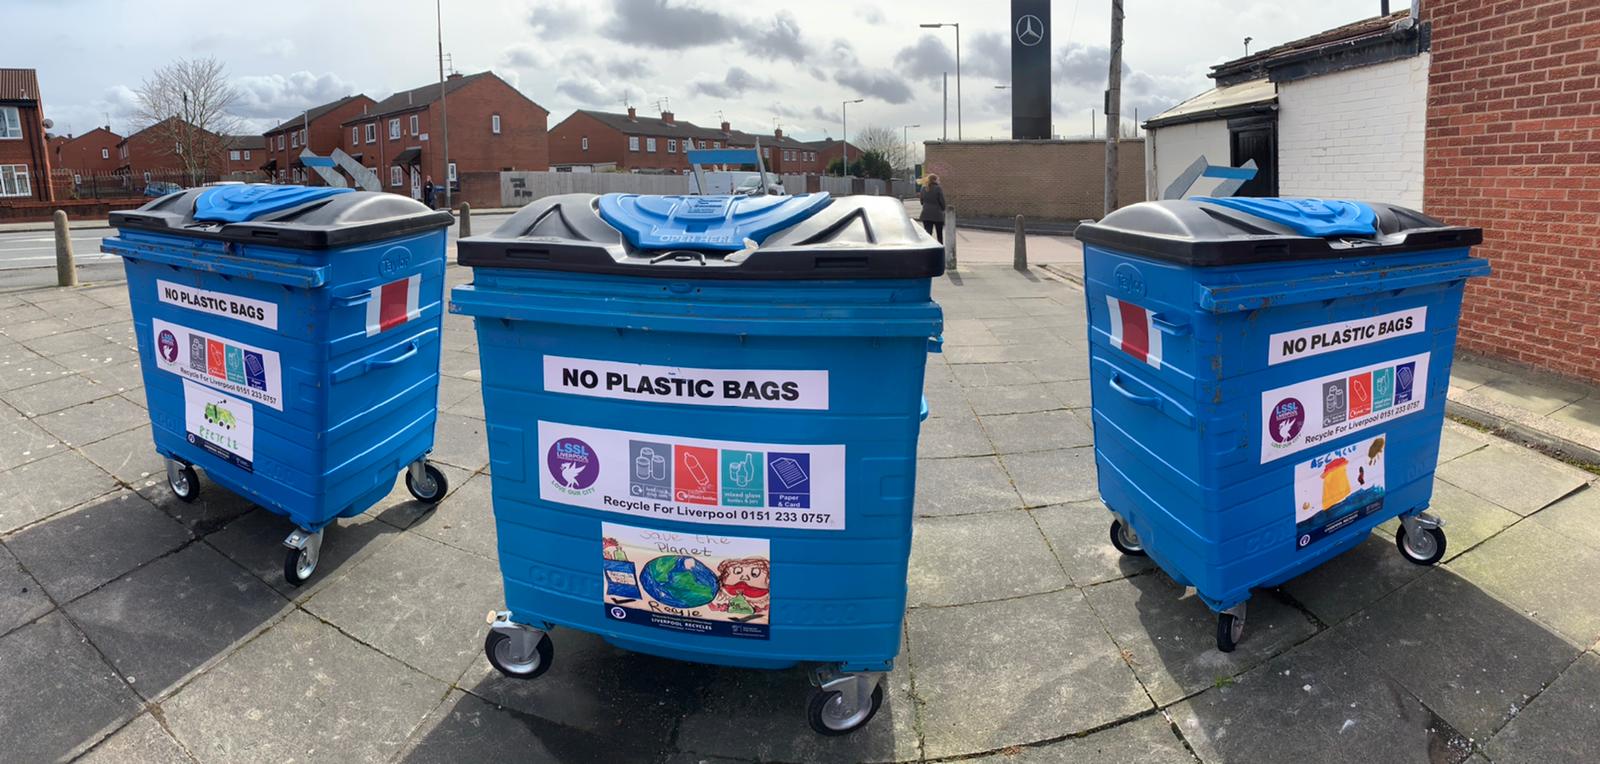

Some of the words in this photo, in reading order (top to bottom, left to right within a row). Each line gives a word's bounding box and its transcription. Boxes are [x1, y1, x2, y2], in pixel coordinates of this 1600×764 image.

[660, 234, 696, 243] OPEN
[165, 287, 178, 301] NO
[181, 291, 227, 312] PLASTIC
[231, 301, 264, 321] BAGS
[1282, 337, 1307, 356] NO
[1311, 324, 1375, 350] PLASTIC
[1378, 316, 1413, 336] BAGS
[180, 366, 199, 379] Recycle
[200, 373, 209, 382] For
[209, 377, 236, 391] Liverpool
[562, 368, 598, 389] NO
[606, 371, 714, 399] PLASTIC
[722, 380, 799, 401] BAGS
[1276, 402, 1298, 414] LSSL
[1305, 429, 1334, 444] Recycle
[1335, 424, 1347, 434] For
[1348, 414, 1379, 430] Liverpool
[1380, 410, 1394, 419] 0151
[1395, 405, 1406, 414] 233
[1407, 400, 1420, 411] 0757
[557, 442, 589, 456] LSSL
[557, 452, 589, 462] LIVERPOOL
[552, 480, 566, 492] LOVE
[582, 487, 596, 496] CITY
[604, 495, 650, 511] Recycle
[653, 503, 674, 514] For
[677, 506, 736, 519] Liverpool
[741, 510, 770, 521] 0151
[775, 511, 797, 521] 233
[801, 513, 830, 524] 0757
[640, 531, 681, 541] Save
[696, 534, 731, 544] the
[654, 541, 712, 556] Planet
[651, 617, 683, 627] LIVERPOOL
